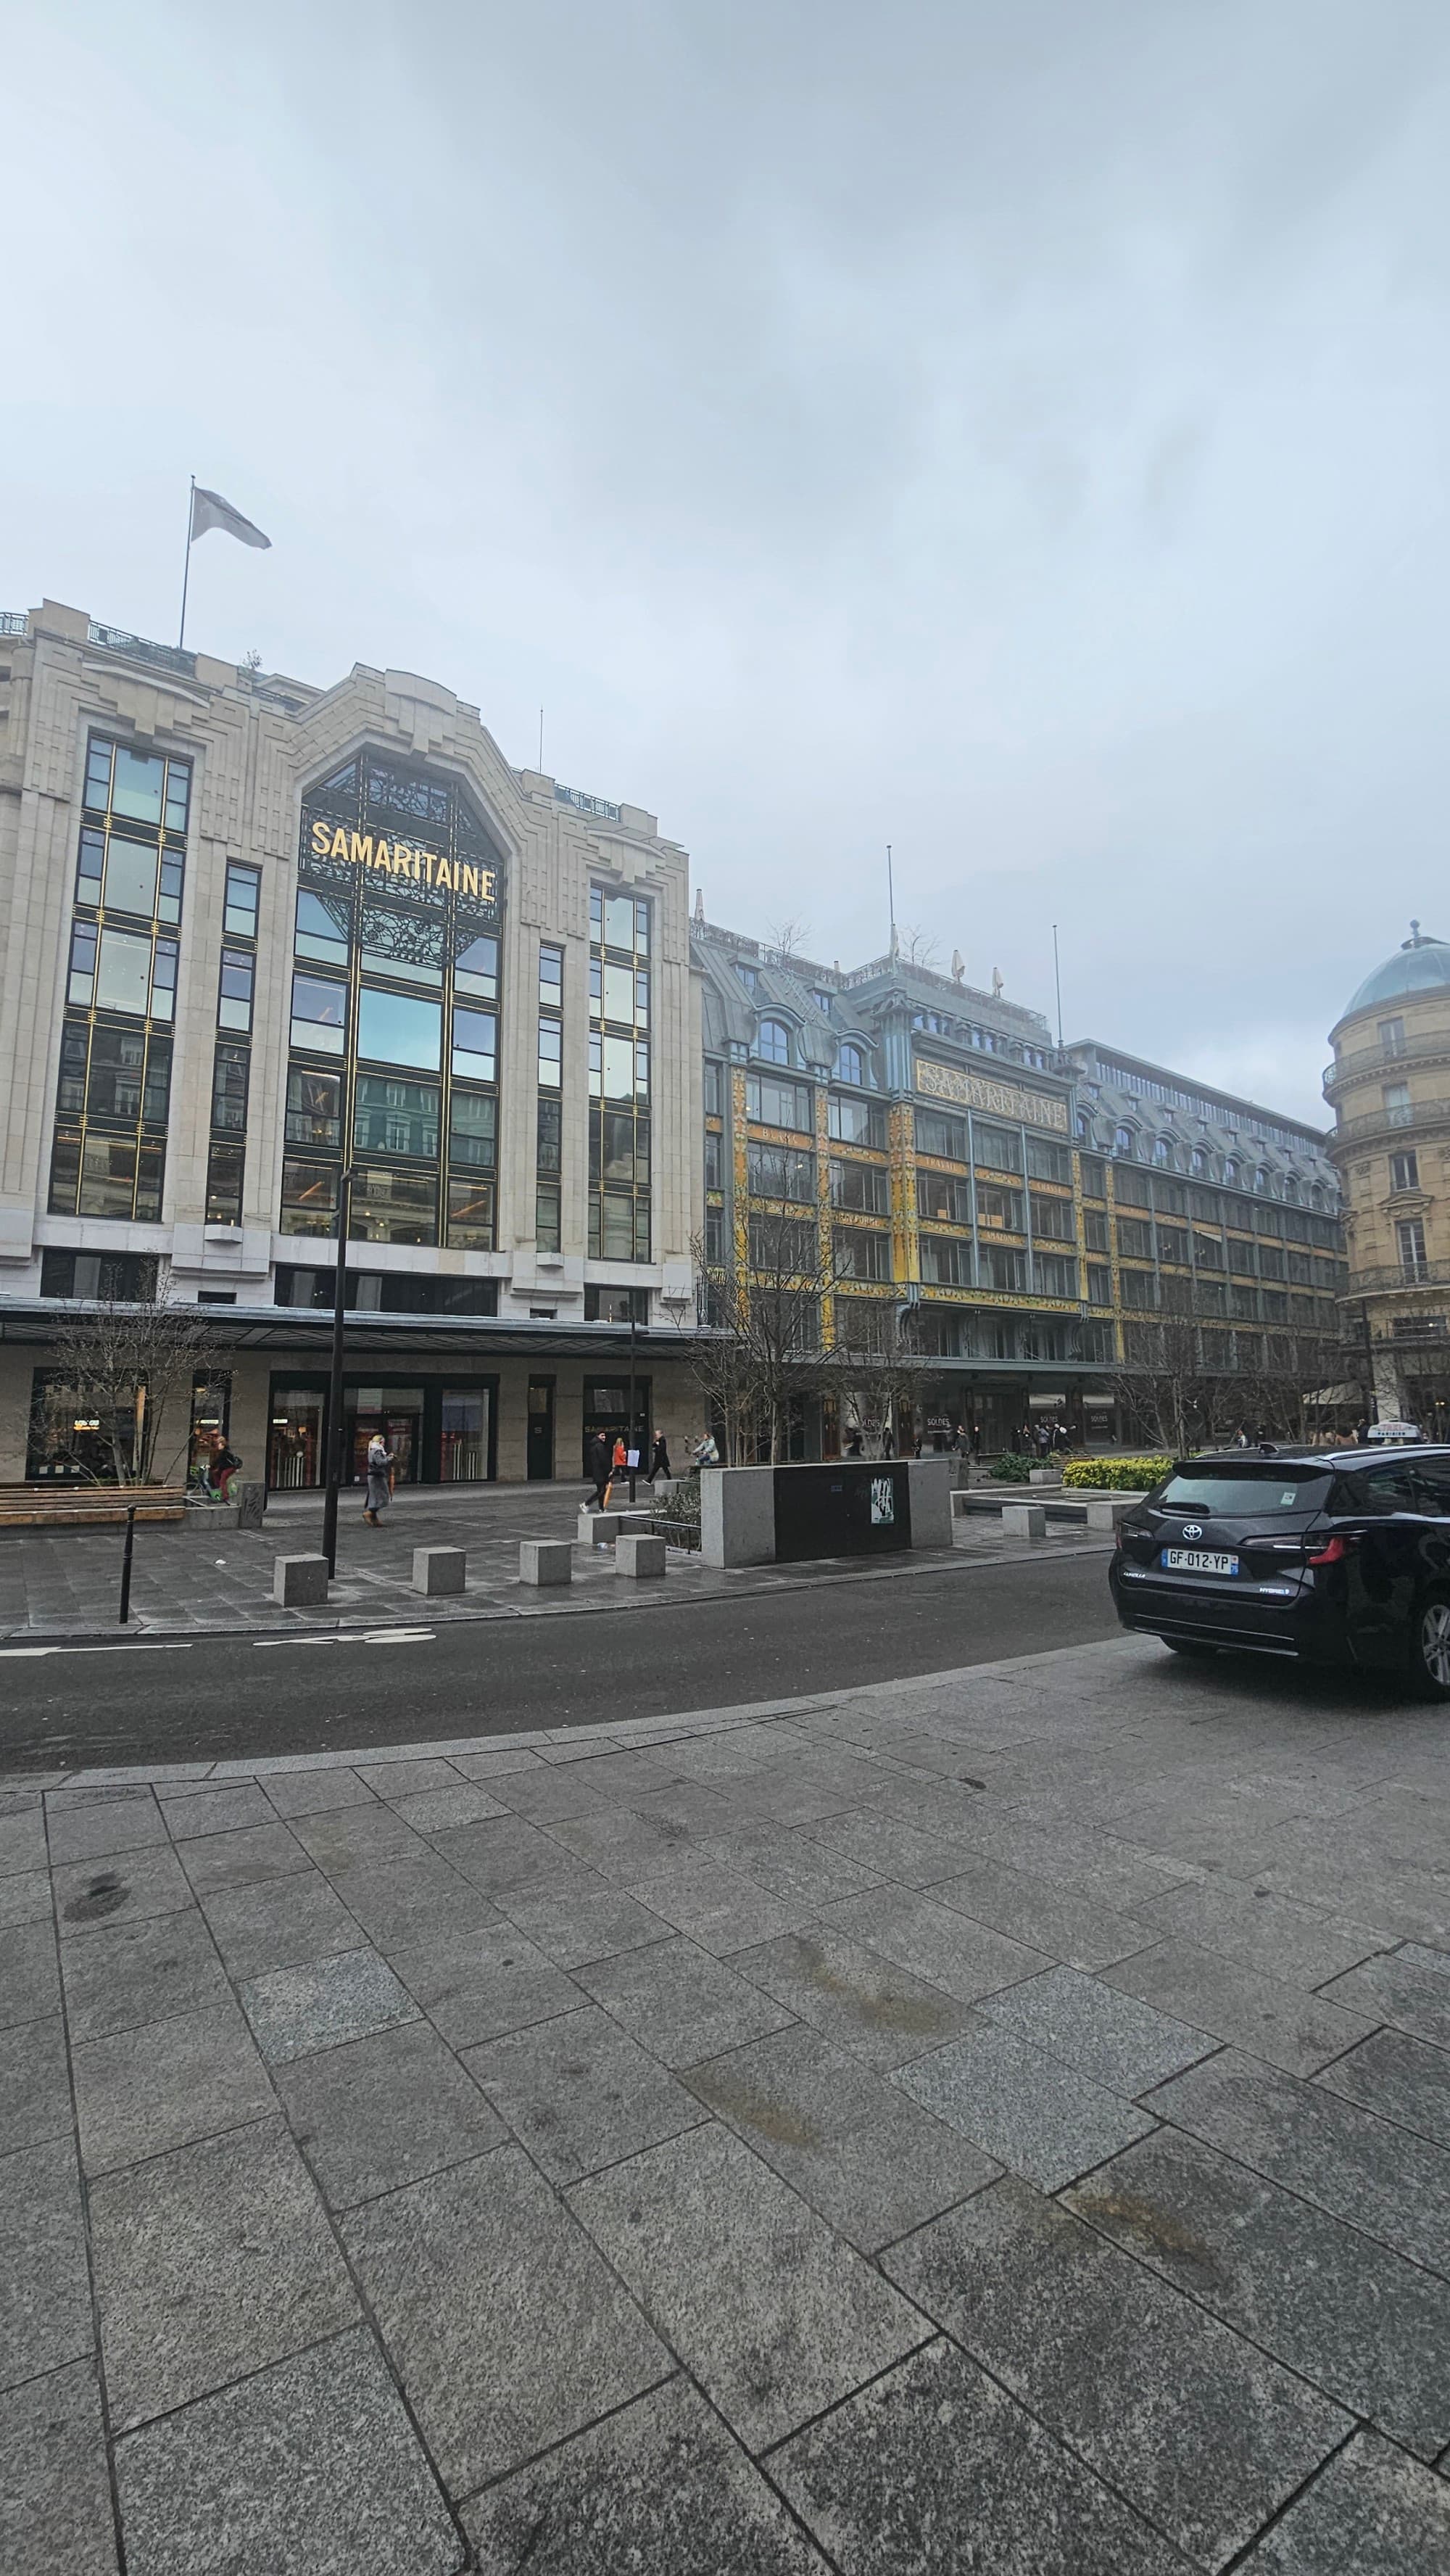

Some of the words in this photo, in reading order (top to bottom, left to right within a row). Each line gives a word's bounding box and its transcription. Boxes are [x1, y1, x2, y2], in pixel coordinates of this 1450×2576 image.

[312, 821, 496, 902] SAMARITAINE
[925, 1066, 1064, 1128] SAMARITAINE
[926, 1157, 956, 1170] TRAVAIL
[987, 1231, 1017, 1243] AMAZONE
[927, 1418, 950, 1427] SOLDES
[1169, 1551, 1229, 1570] GF-012-YP
